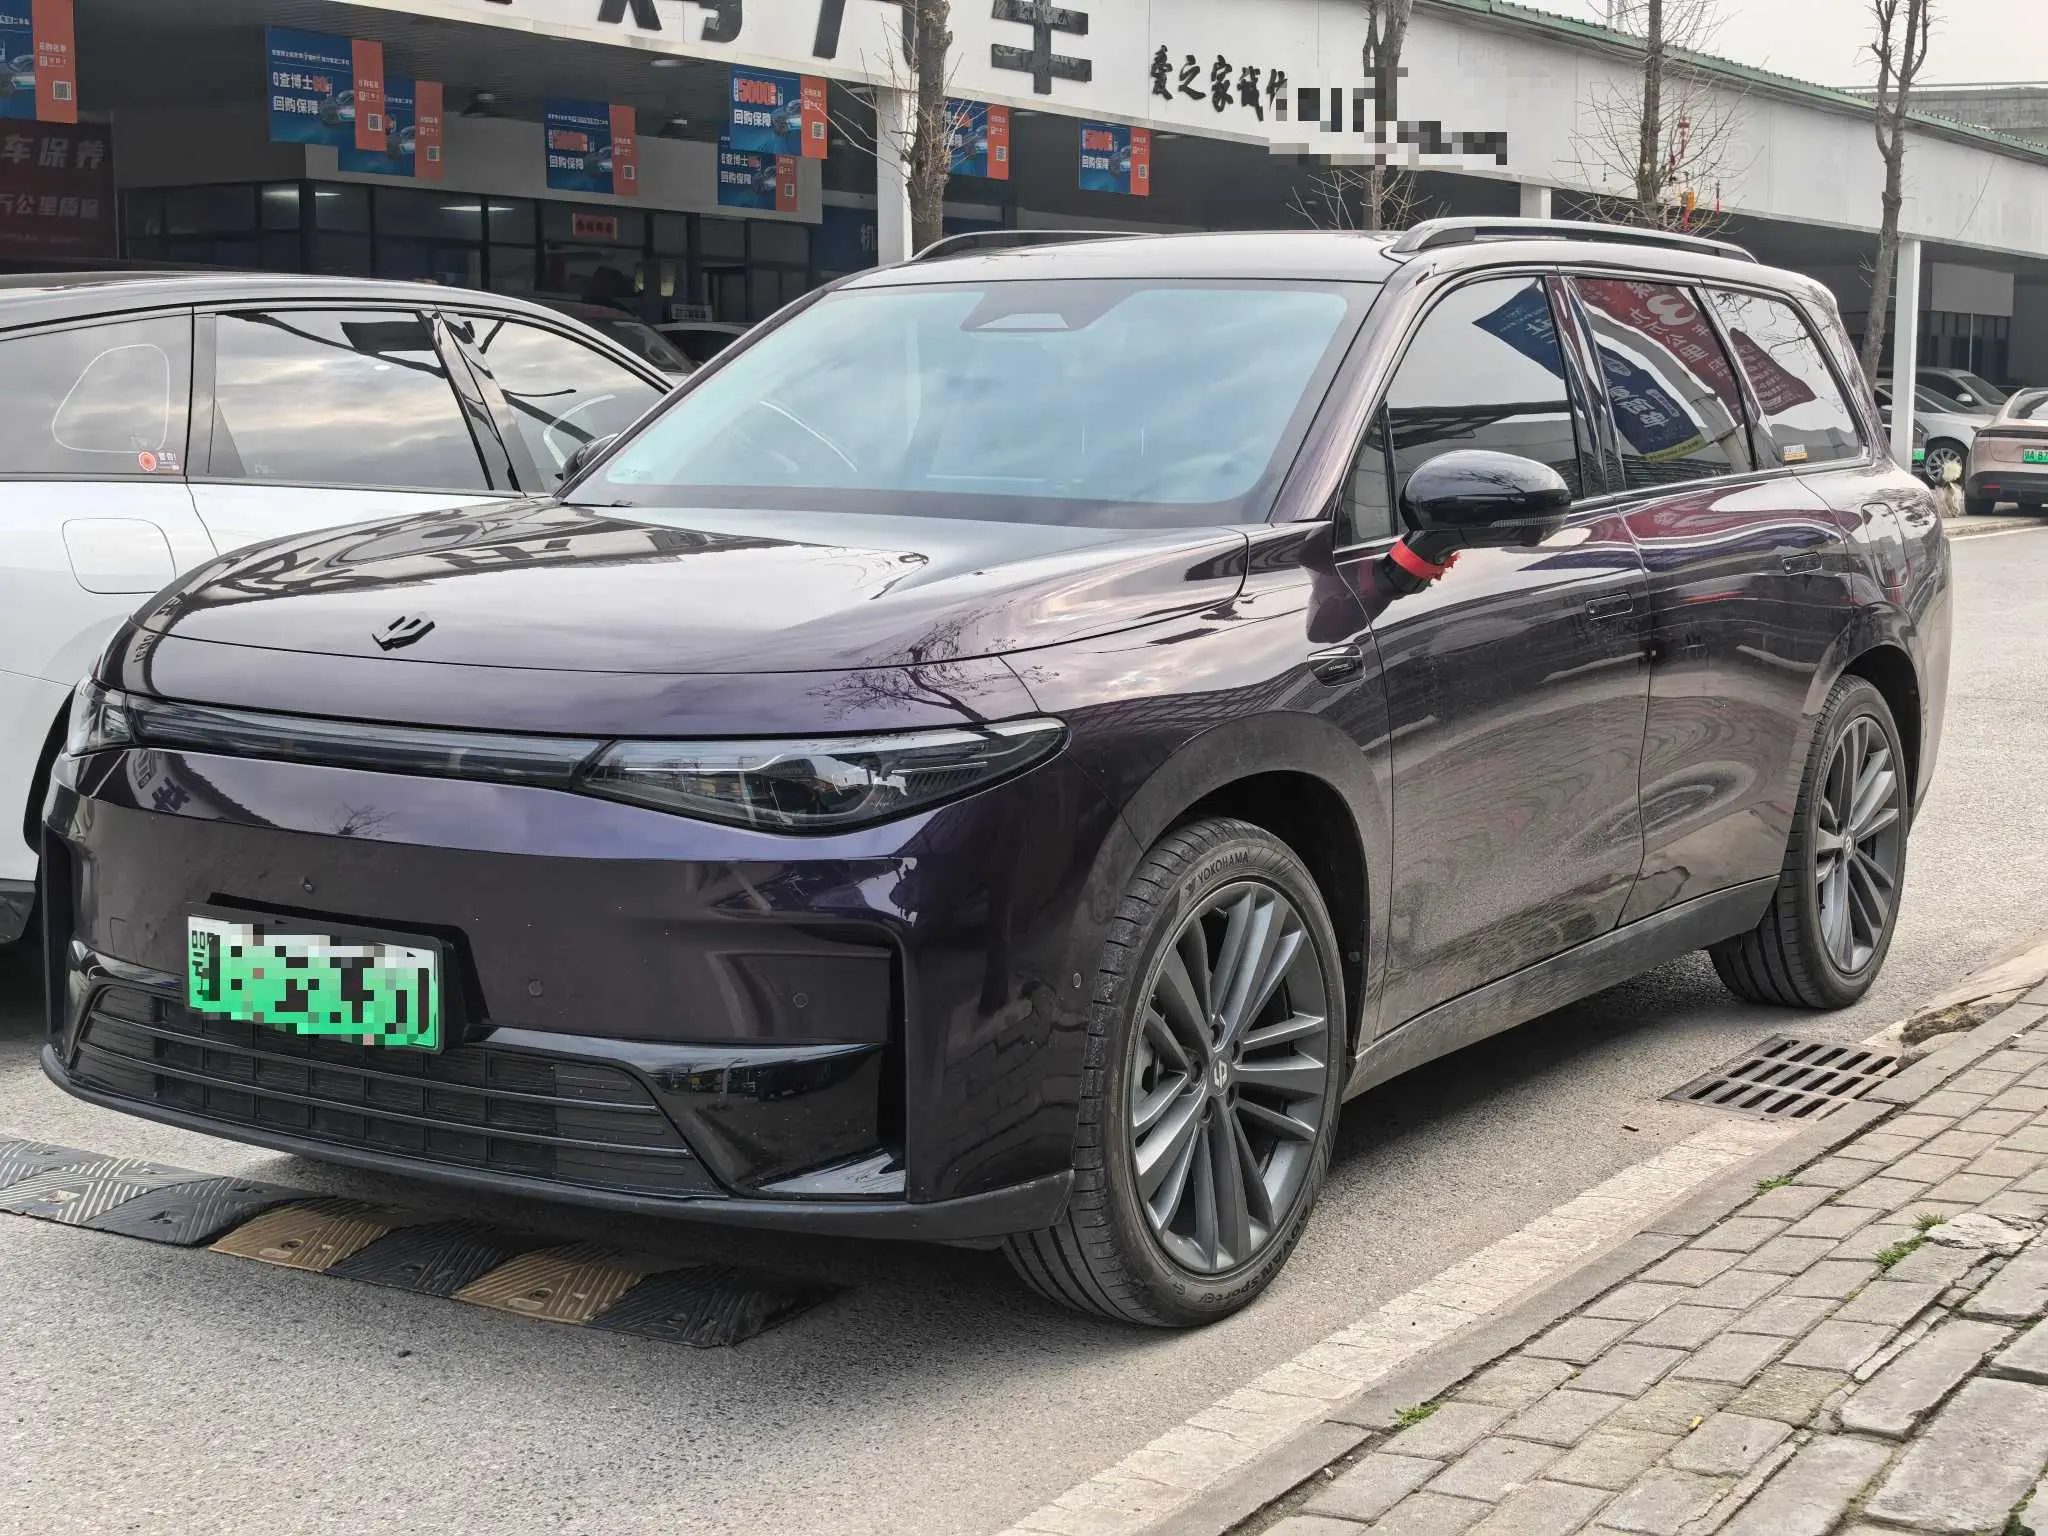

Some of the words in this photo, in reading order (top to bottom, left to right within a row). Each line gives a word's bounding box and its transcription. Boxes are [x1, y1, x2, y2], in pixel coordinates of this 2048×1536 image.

[272, 95, 319, 116] 回购保障
[733, 109, 772, 128] 回购保障
[549, 154, 584, 171] 回购保障
[1197, 851, 1249, 884] YOKOHAMA
